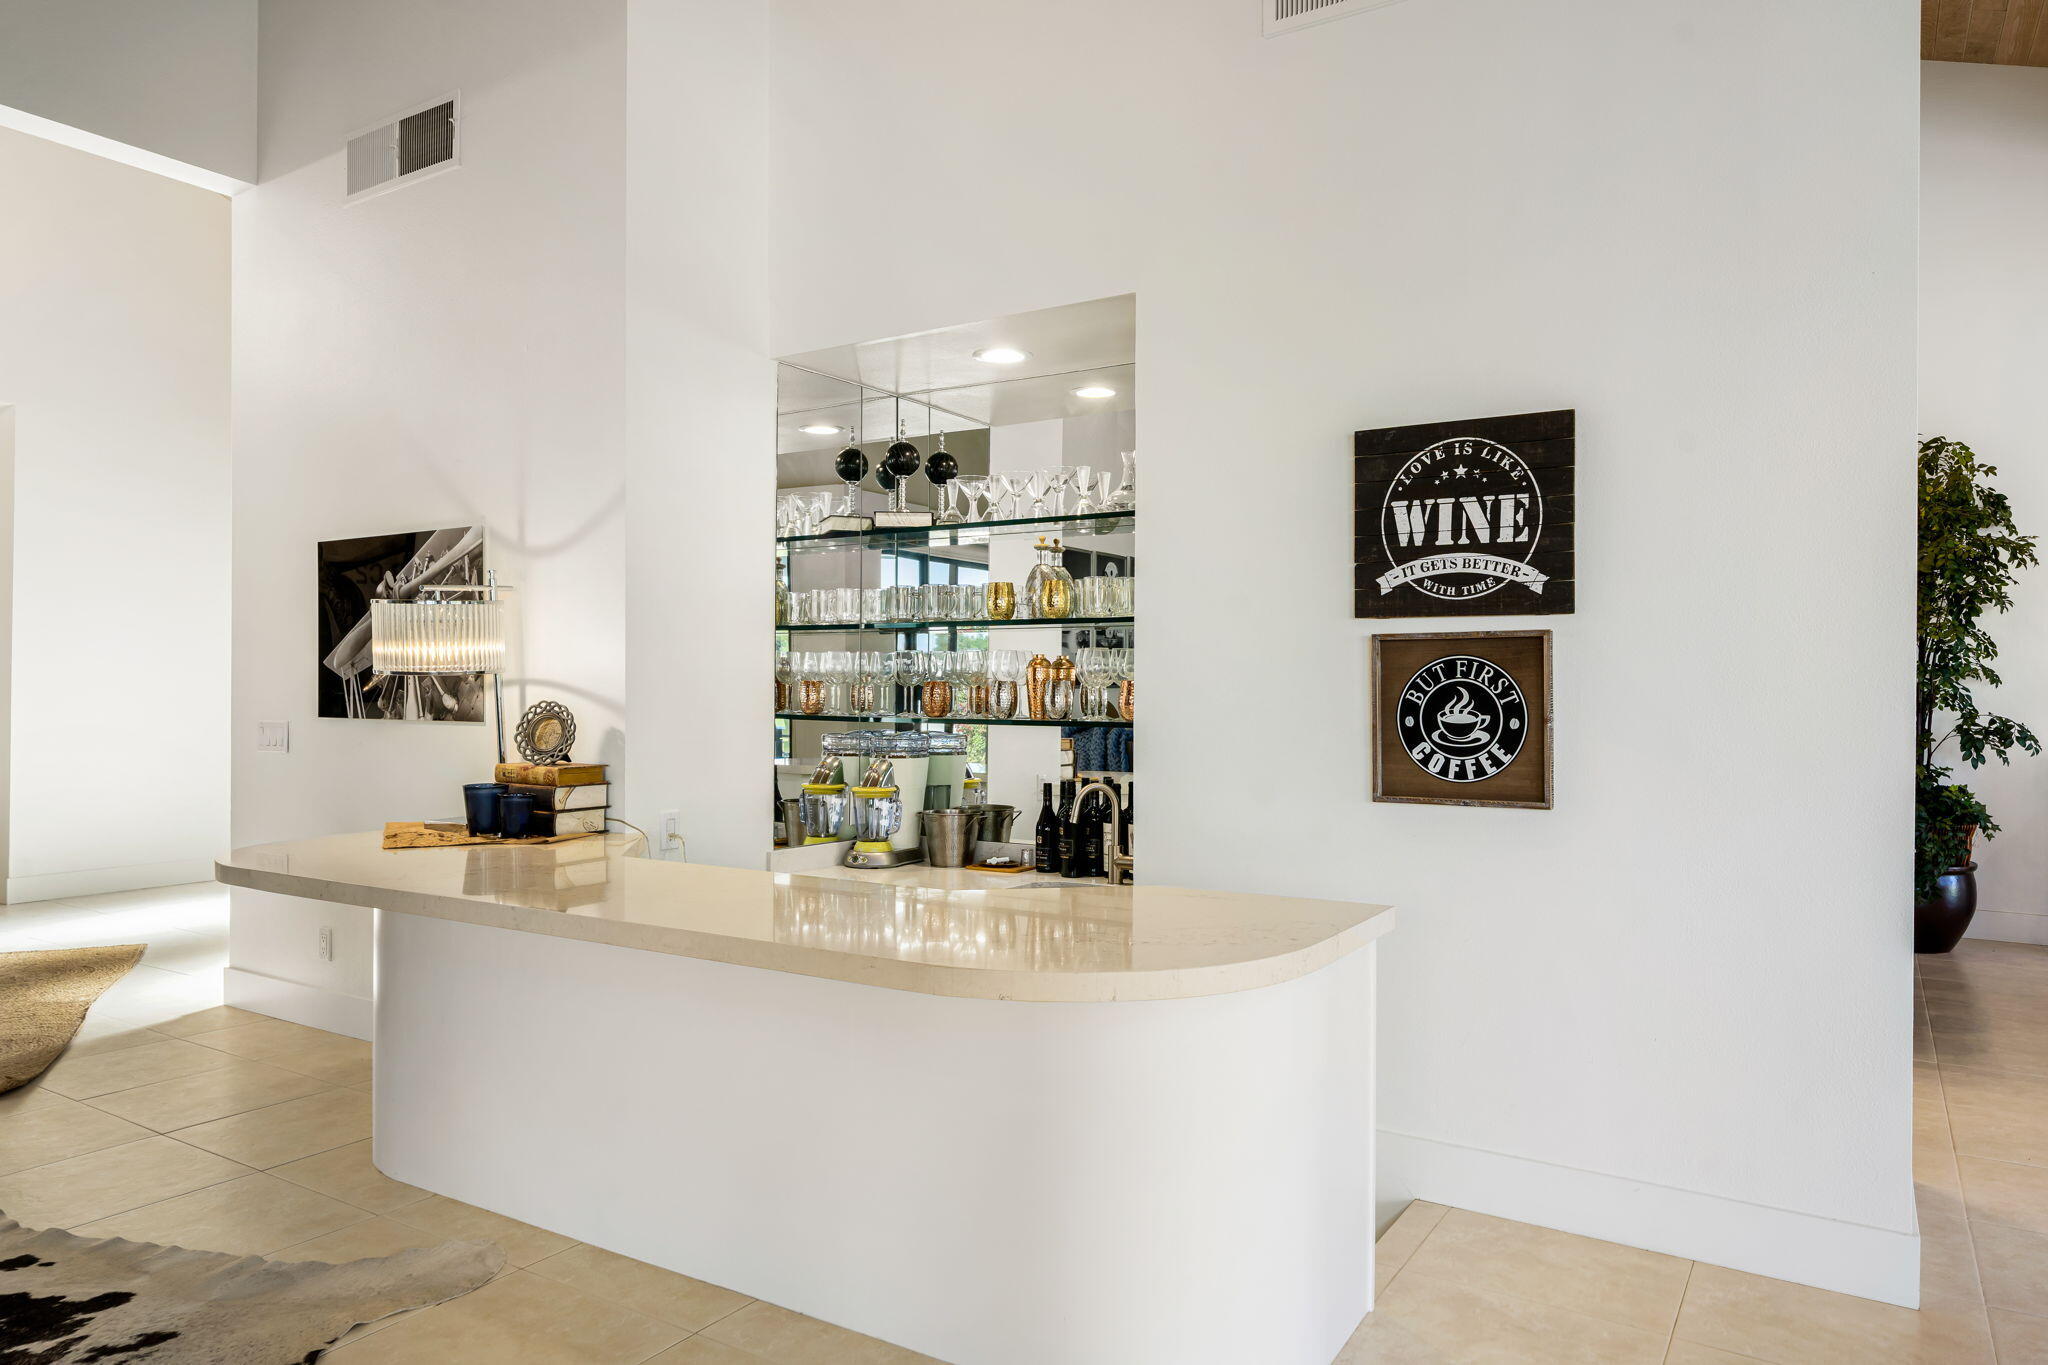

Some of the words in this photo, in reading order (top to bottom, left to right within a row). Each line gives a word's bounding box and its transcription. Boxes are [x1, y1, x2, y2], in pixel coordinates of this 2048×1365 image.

[1400, 447, 1445, 485] LOVE
[1454, 442, 1473, 455] IS
[1481, 446, 1524, 480] LIKE
[1390, 493, 1530, 547] WINE
[1402, 565, 1416, 578] IT
[1420, 558, 1458, 572] GETS
[1462, 558, 1522, 578] BETTER
[1423, 578, 1456, 596] WITH
[1461, 577, 1496, 596] TIME
[1405, 663, 1447, 706] BUT
[1456, 660, 1520, 705] FIRST
[1411, 741, 1513, 780] COFFEE
